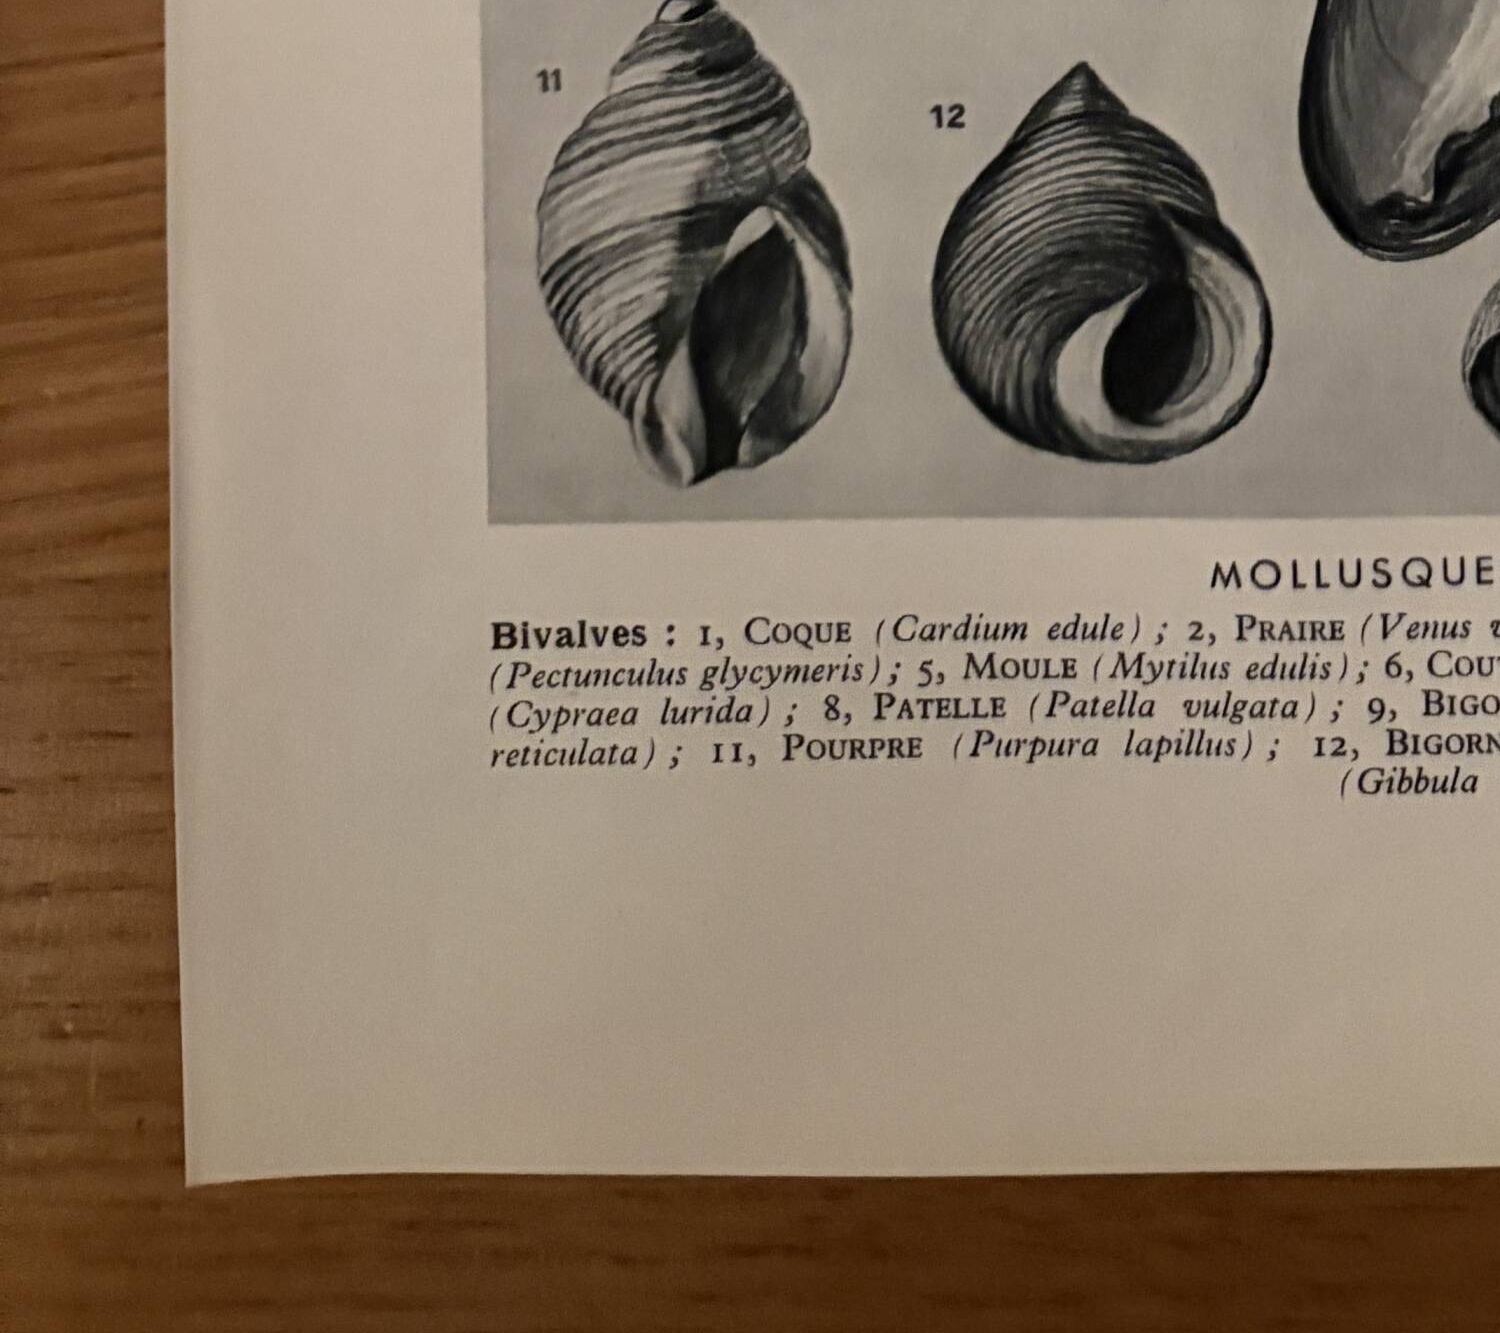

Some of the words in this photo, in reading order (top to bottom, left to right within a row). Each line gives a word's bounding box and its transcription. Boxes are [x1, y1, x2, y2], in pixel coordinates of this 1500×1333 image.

[535, 68, 562, 94] 11
[928, 102, 966, 130] 12
[744, 615, 852, 651] COQUE
[876, 612, 1029, 648] (Cardium
[1187, 620, 1217, 648] 2,
[1235, 613, 1346, 644] PRAIRE
[1361, 612, 1473, 647] (Venus
[489, 657, 688, 694] (Pectunculus
[916, 658, 946, 689] 5,
[963, 651, 1078, 682] MOULE
[1092, 650, 1231, 687] (Mytilus
[1384, 650, 1414, 685] 6,
[489, 699, 640, 735] (Cypraea
[823, 693, 853, 727] 8,
[872, 691, 1007, 722] PATELLE
[1029, 688, 1156, 724] (Patella
[1366, 696, 1398, 726] 9,
[781, 732, 924, 763] POURPRE
[953, 728, 1100, 765] (Purpura
[1313, 735, 1360, 763] 12,
[1340, 765, 1479, 800] (Gibbula
